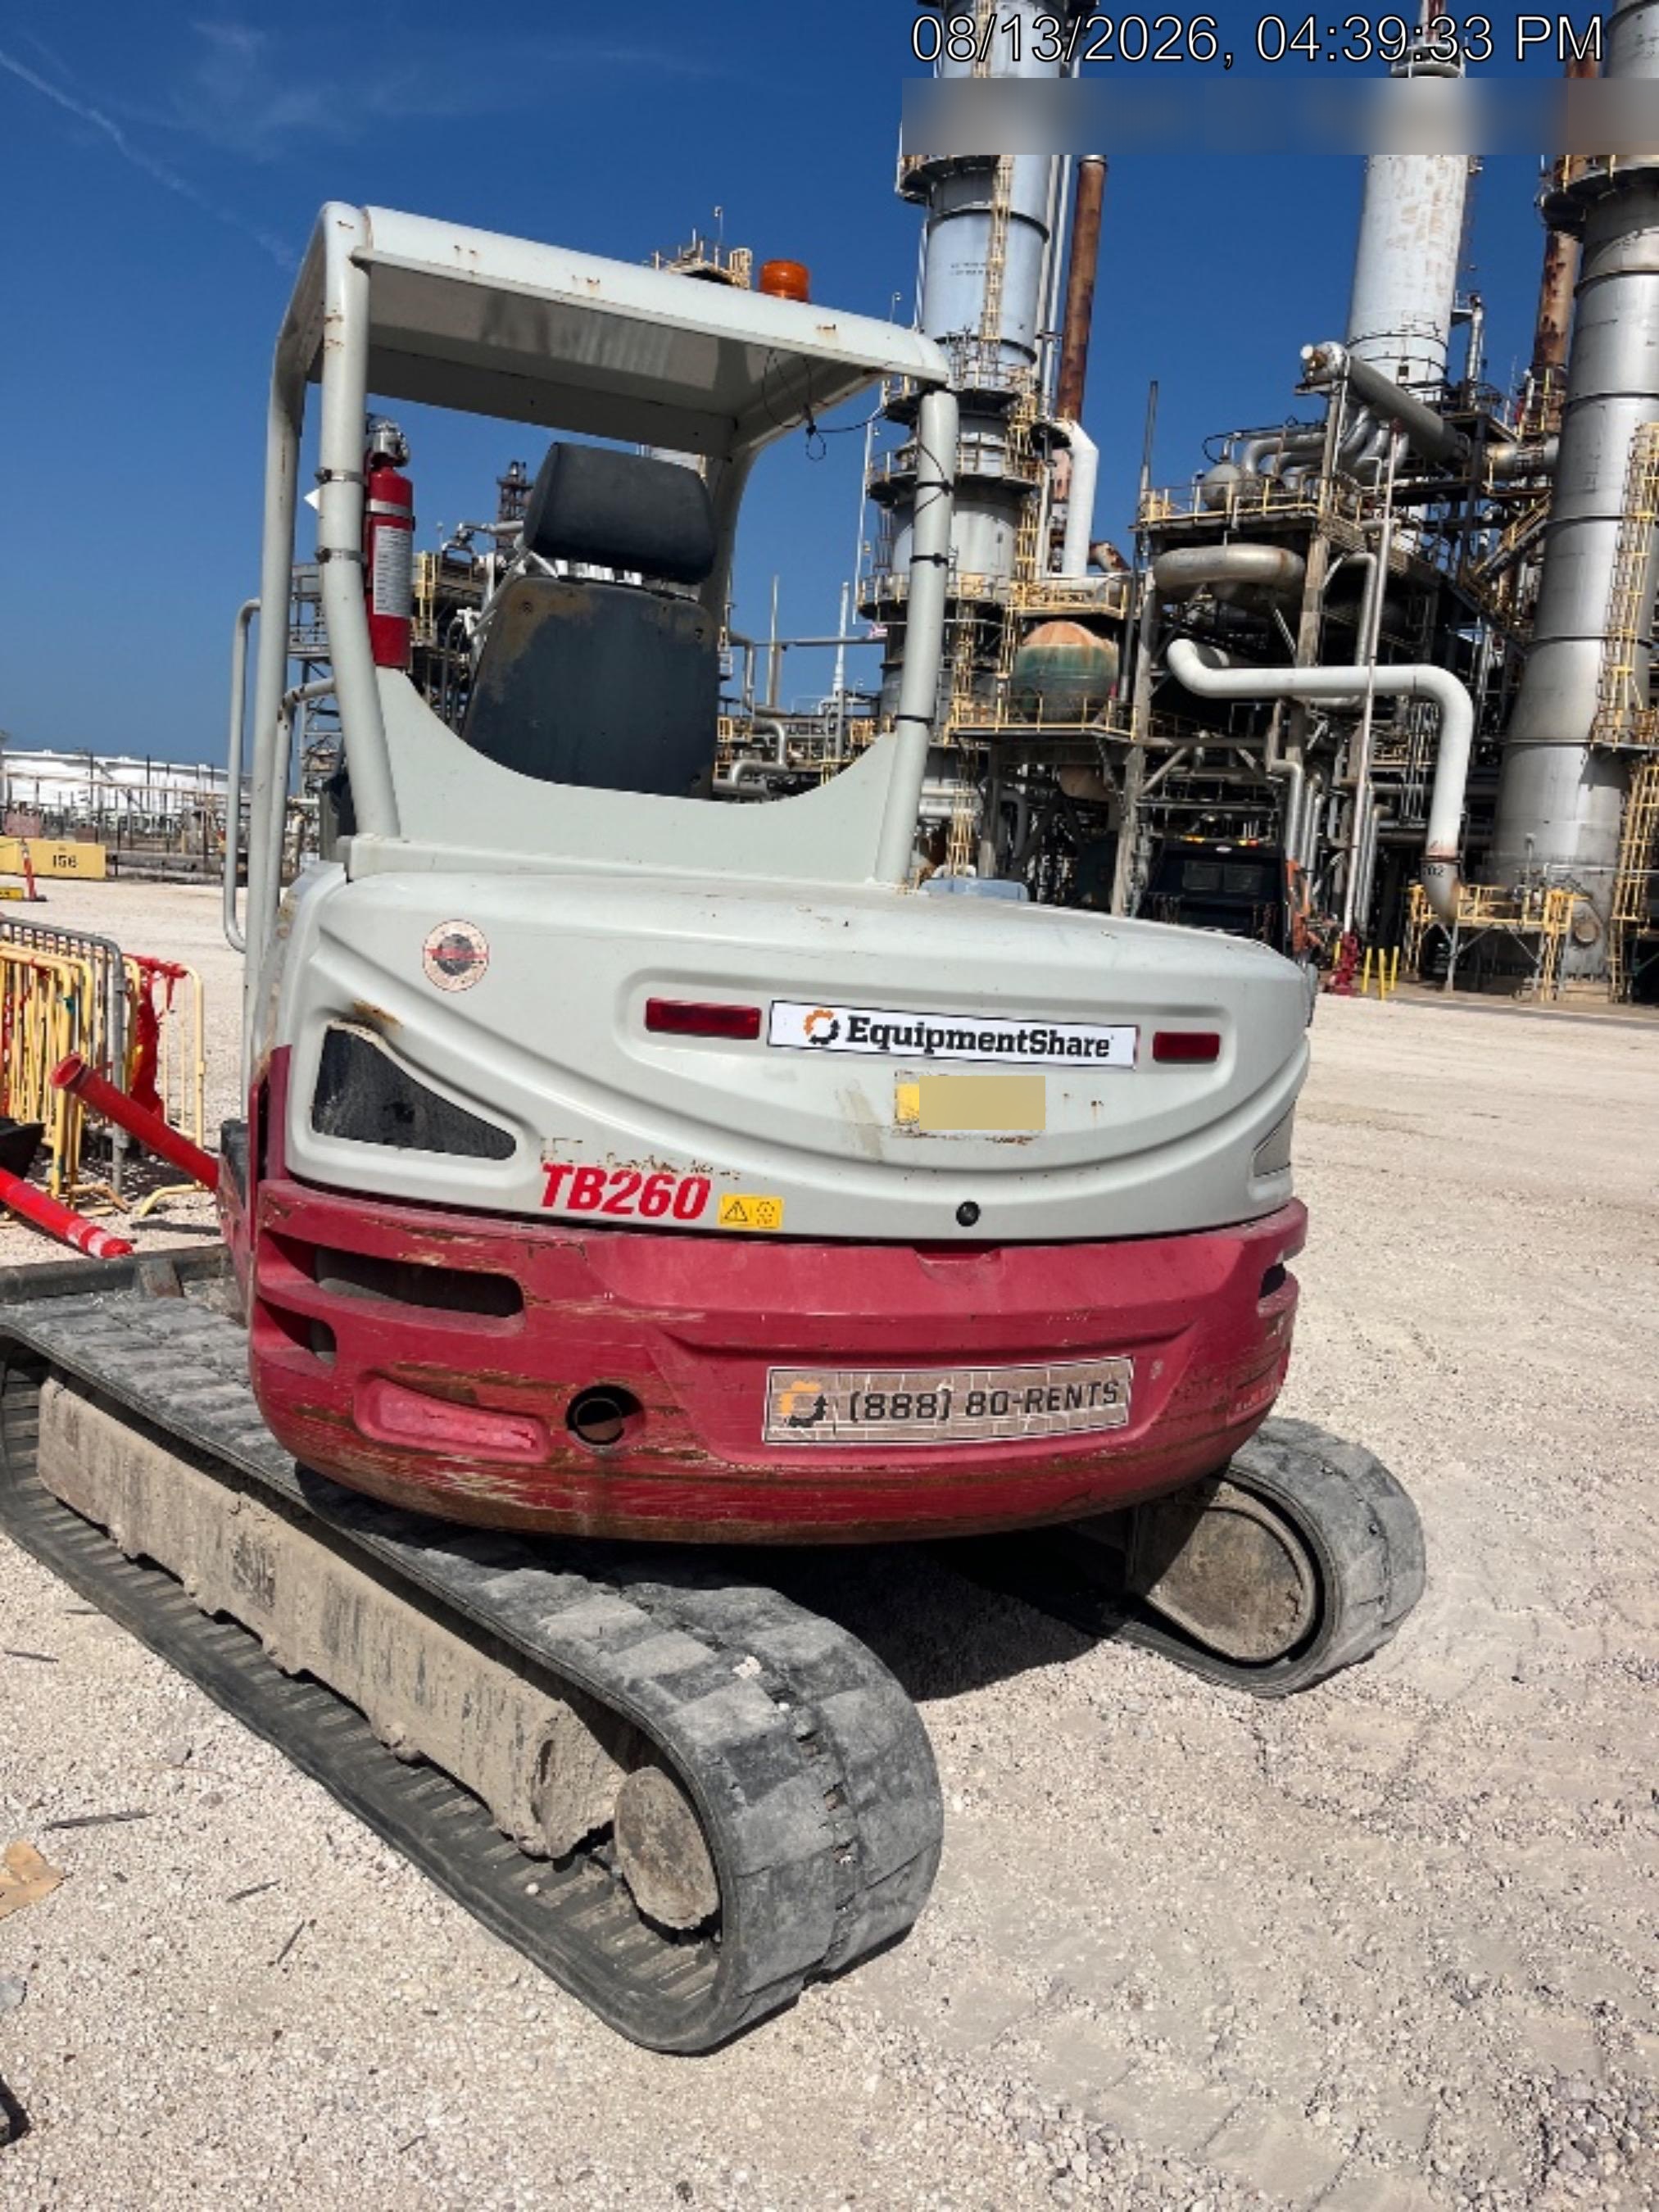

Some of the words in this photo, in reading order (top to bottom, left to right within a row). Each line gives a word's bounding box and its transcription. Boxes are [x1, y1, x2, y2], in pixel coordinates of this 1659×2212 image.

[845, 1015, 1110, 1058] EquipmentShare
[541, 1163, 711, 1220] TB260
[850, 1390, 950, 1421] (888)
[965, 1380, 1119, 1416] 80-RENTS
